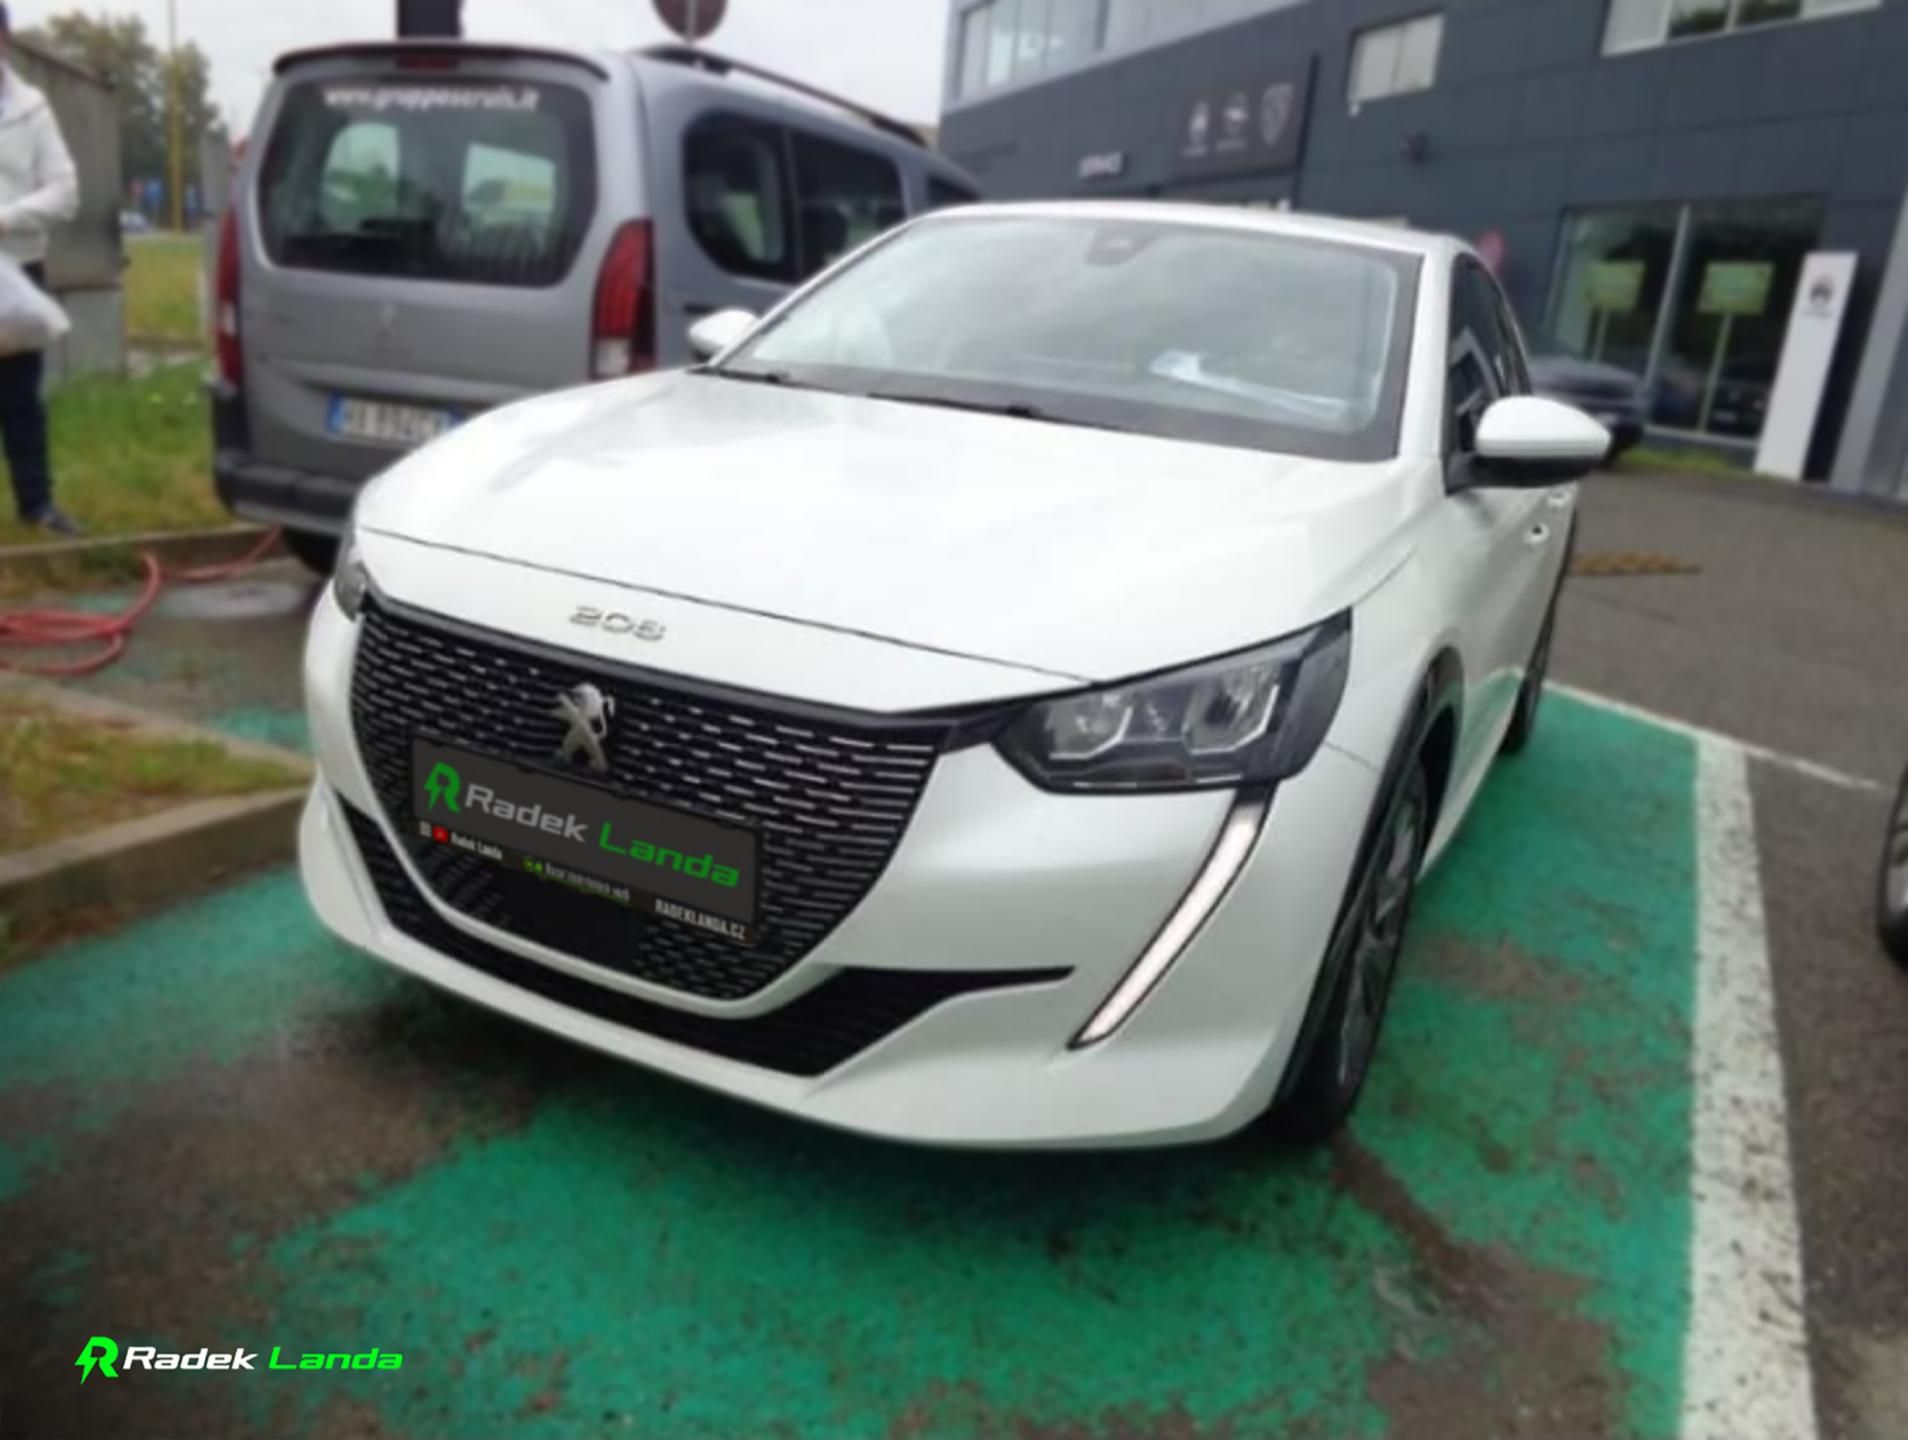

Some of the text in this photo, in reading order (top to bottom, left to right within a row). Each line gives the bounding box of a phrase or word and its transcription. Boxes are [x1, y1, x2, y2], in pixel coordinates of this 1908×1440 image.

[465, 783, 588, 843] Radek
[598, 821, 739, 887] Landa
[655, 899, 745, 940] RADEKLANDA.CZ
